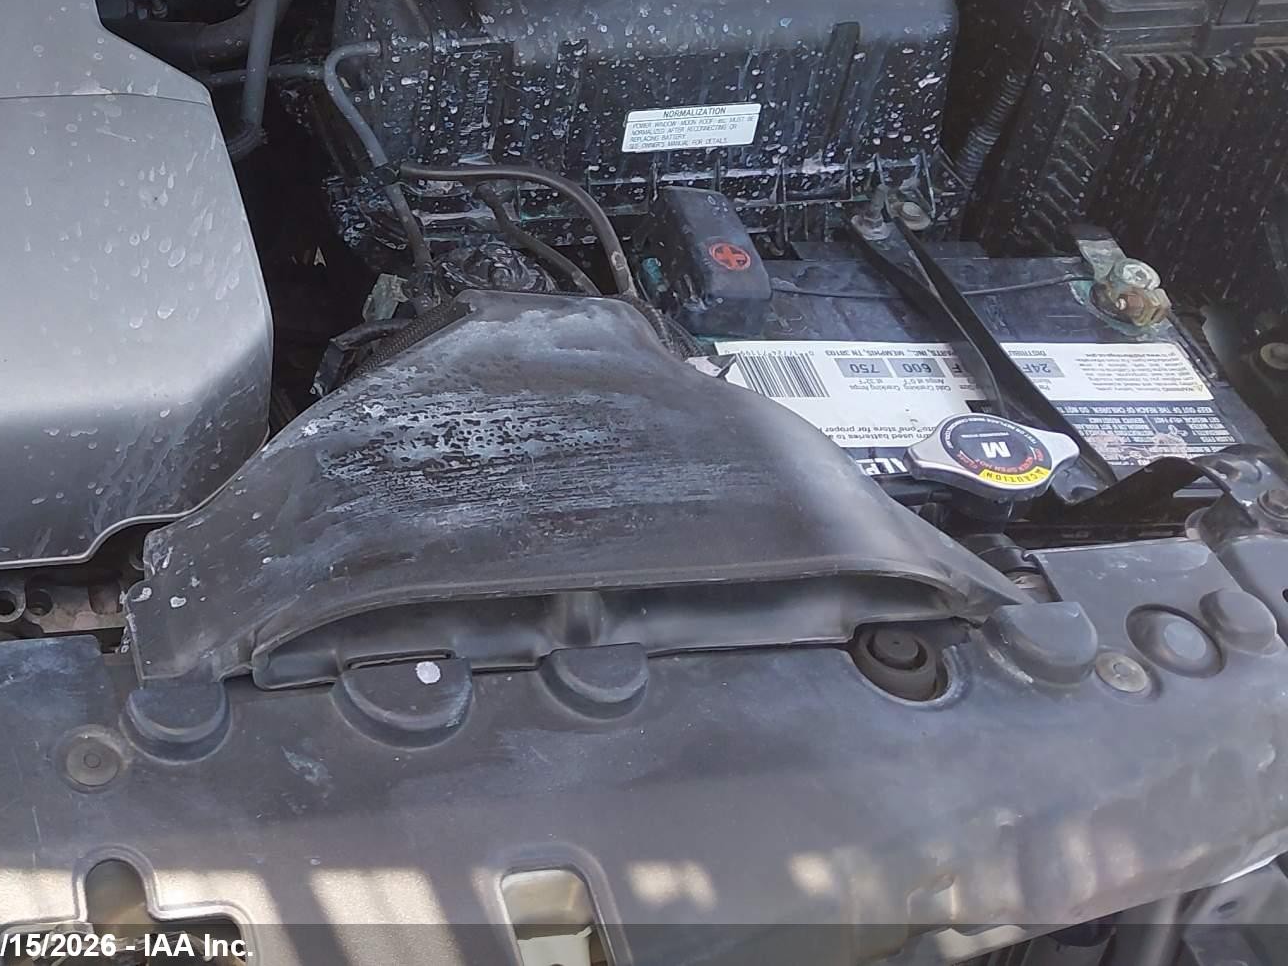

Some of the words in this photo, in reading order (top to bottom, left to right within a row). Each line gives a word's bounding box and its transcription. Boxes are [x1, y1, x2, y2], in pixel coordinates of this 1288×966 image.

[663, 106, 727, 118] NORMALIZATION
[849, 364, 880, 374] 750
[902, 363, 932, 373] 600
[980, 442, 1011, 458] M
[986, 472, 1038, 483] CAUTION
